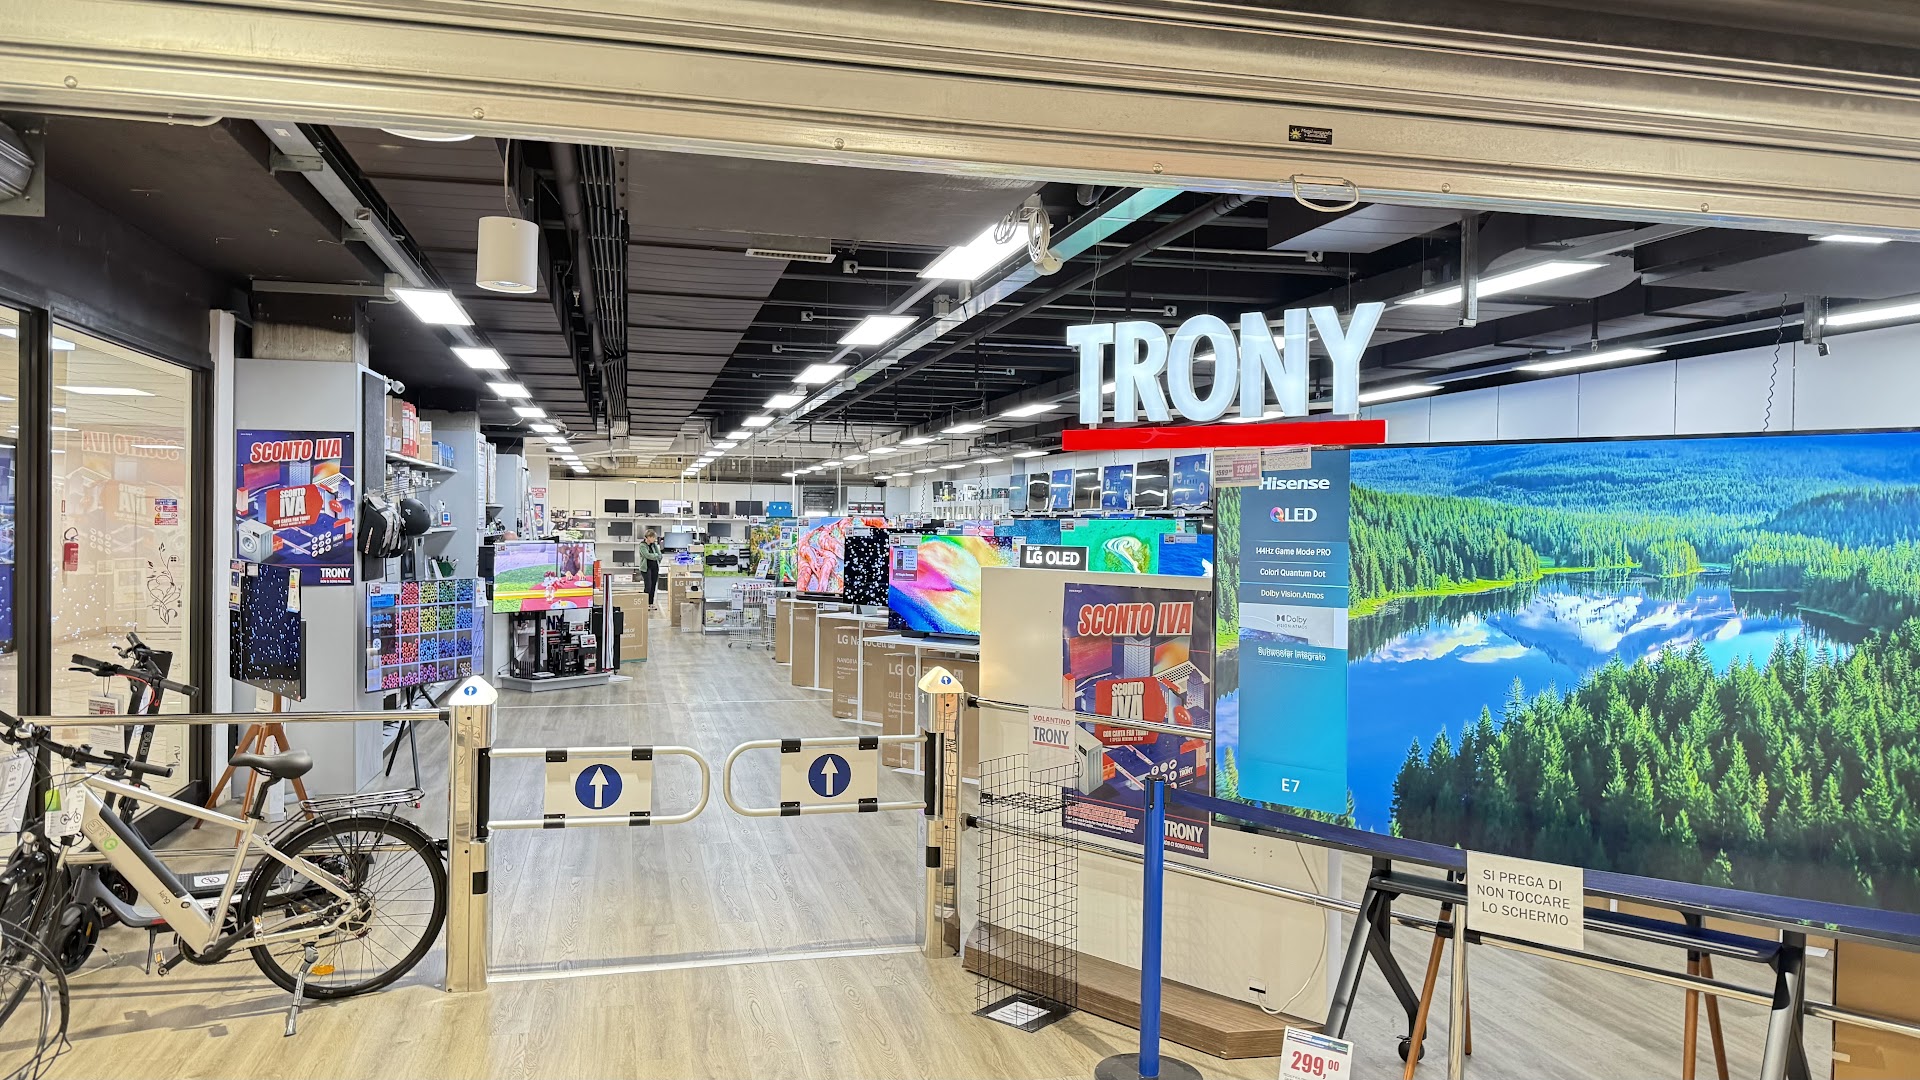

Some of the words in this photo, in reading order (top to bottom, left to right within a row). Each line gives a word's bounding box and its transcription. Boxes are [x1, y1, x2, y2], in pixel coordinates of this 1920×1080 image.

[1066, 302, 1386, 423] TRONY
[251, 441, 313, 462] SCONTO
[315, 439, 342, 460] IVA
[1259, 477, 1330, 490] Hisense
[280, 488, 306, 499] SCONTO
[280, 498, 306, 518] IVA
[1270, 507, 1318, 522] QLED
[1026, 551, 1042, 564] LG
[1046, 551, 1080, 565] OLED
[1256, 547, 1274, 555] 144Hz
[1296, 548, 1315, 556] Mode
[320, 568, 351, 578] TRONY
[1280, 569, 1312, 578] Quantum
[1313, 570, 1326, 578] Dot
[1261, 590, 1280, 599] Dolby
[1078, 603, 1156, 636] SCONTO
[1156, 602, 1193, 635] IVA
[1286, 615, 1308, 625] Dolby
[837, 634, 848, 644] LG
[1258, 647, 1294, 658] Subwoofer
[889, 664, 902, 676] LG
[1112, 682, 1145, 696] SCONTO
[1112, 694, 1144, 721] IVA
[1033, 715, 1070, 725] VOLANTINO
[1033, 726, 1069, 745] TRONY
[1281, 778, 1299, 793] E7
[1164, 820, 1204, 843] TRONY
[1483, 870, 1495, 881] SI
[1499, 872, 1544, 889] PREGA
[1549, 880, 1562, 891] DI
[1477, 885, 1504, 899] NON
[1508, 890, 1570, 909] TOCCARE
[1482, 902, 1498, 914] LO
[1502, 905, 1569, 926] SCHERMO
